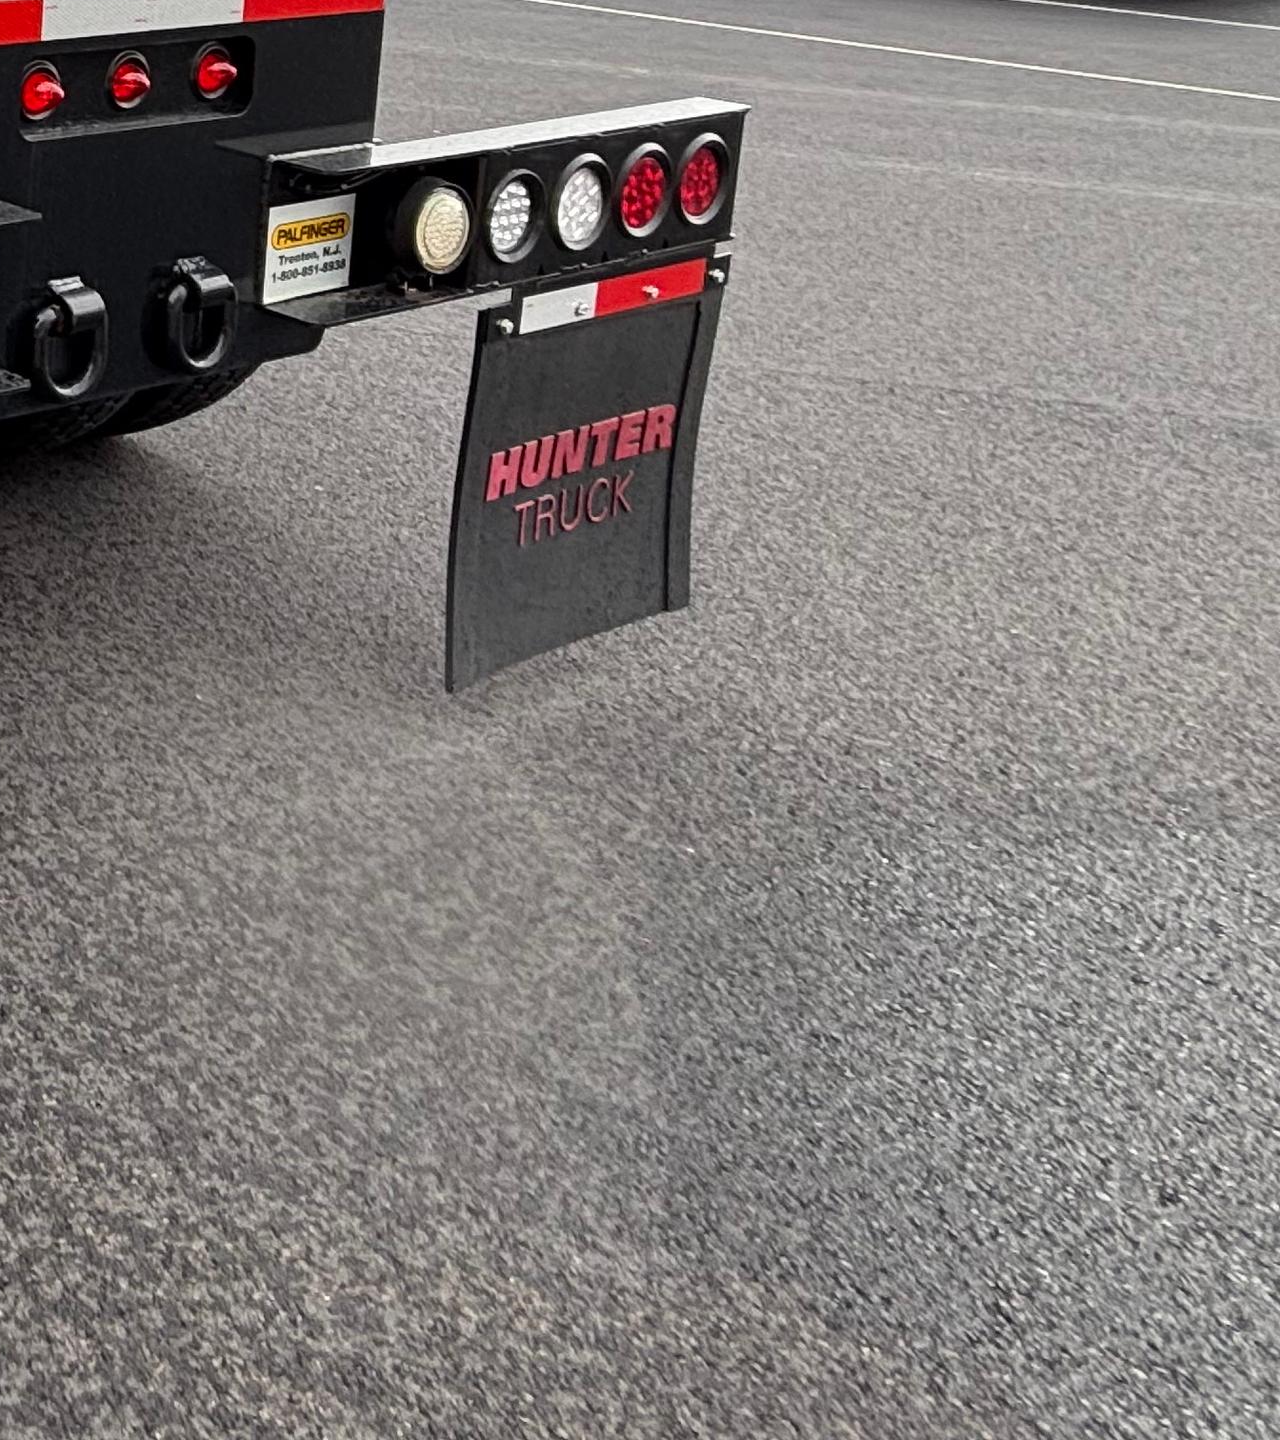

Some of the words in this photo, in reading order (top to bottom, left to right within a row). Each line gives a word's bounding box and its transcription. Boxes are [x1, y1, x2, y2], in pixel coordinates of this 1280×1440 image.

[276, 218, 346, 246] PALFINGER
[322, 244, 342, 258] N.J.
[485, 403, 677, 502] HUNTER
[514, 469, 634, 548] TRUCK
